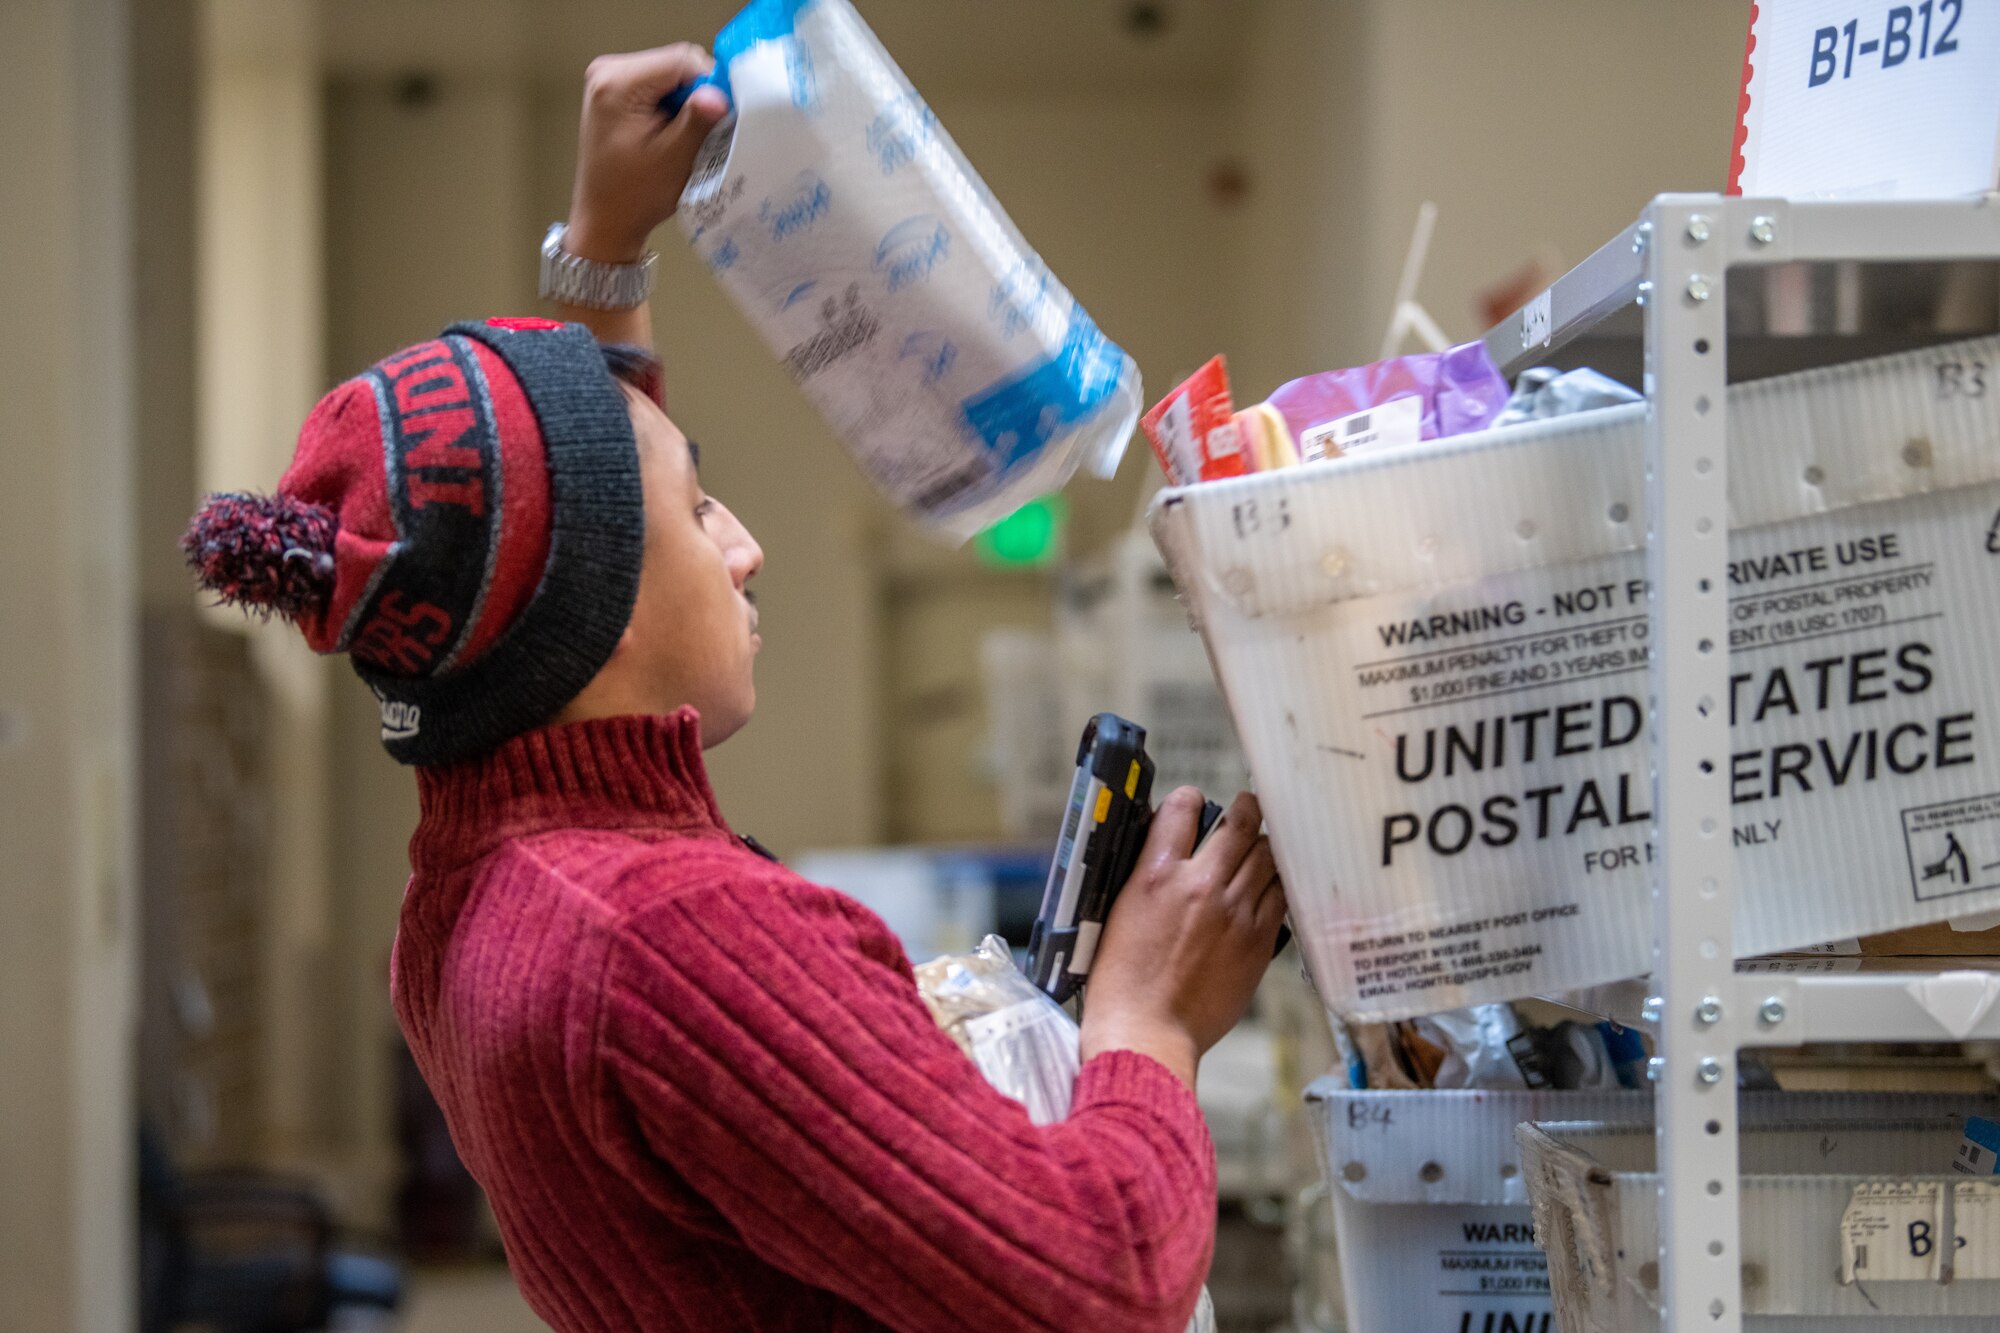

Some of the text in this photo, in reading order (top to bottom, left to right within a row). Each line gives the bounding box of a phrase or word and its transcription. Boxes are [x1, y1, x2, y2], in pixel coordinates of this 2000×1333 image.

[1808, 0, 1963, 88] B1-B12
[1359, 571, 1933, 687] MAXIMUM PENALTY FOR THEFT O OF POSTAL PROPERTY
[1378, 601, 1526, 647] WARNING
[1552, 584, 1616, 617] NOT
[1729, 547, 1829, 585] RIVATE
[1836, 533, 1900, 566] USE
[1467, 671, 1506, 692] FINE
[1506, 664, 1547, 685] AND
[1549, 660, 1562, 678] 3
[1566, 648, 1624, 675] YEARS
[1800, 613, 1836, 634] USC
[1395, 642, 1933, 783] UNITED TATES
[1381, 712, 1975, 867] POSTAL ERVICE
[1583, 845, 1639, 874] FOR
[1733, 819, 1782, 847] NLY
[1350, 935, 1404, 953] RETURN
[1408, 930, 1426, 943] TO
[1429, 918, 1490, 938] NEAREST
[1494, 910, 1528, 929] POST
[1463, 1223, 1535, 1243] WARN
[1907, 1220, 1932, 1257] B
